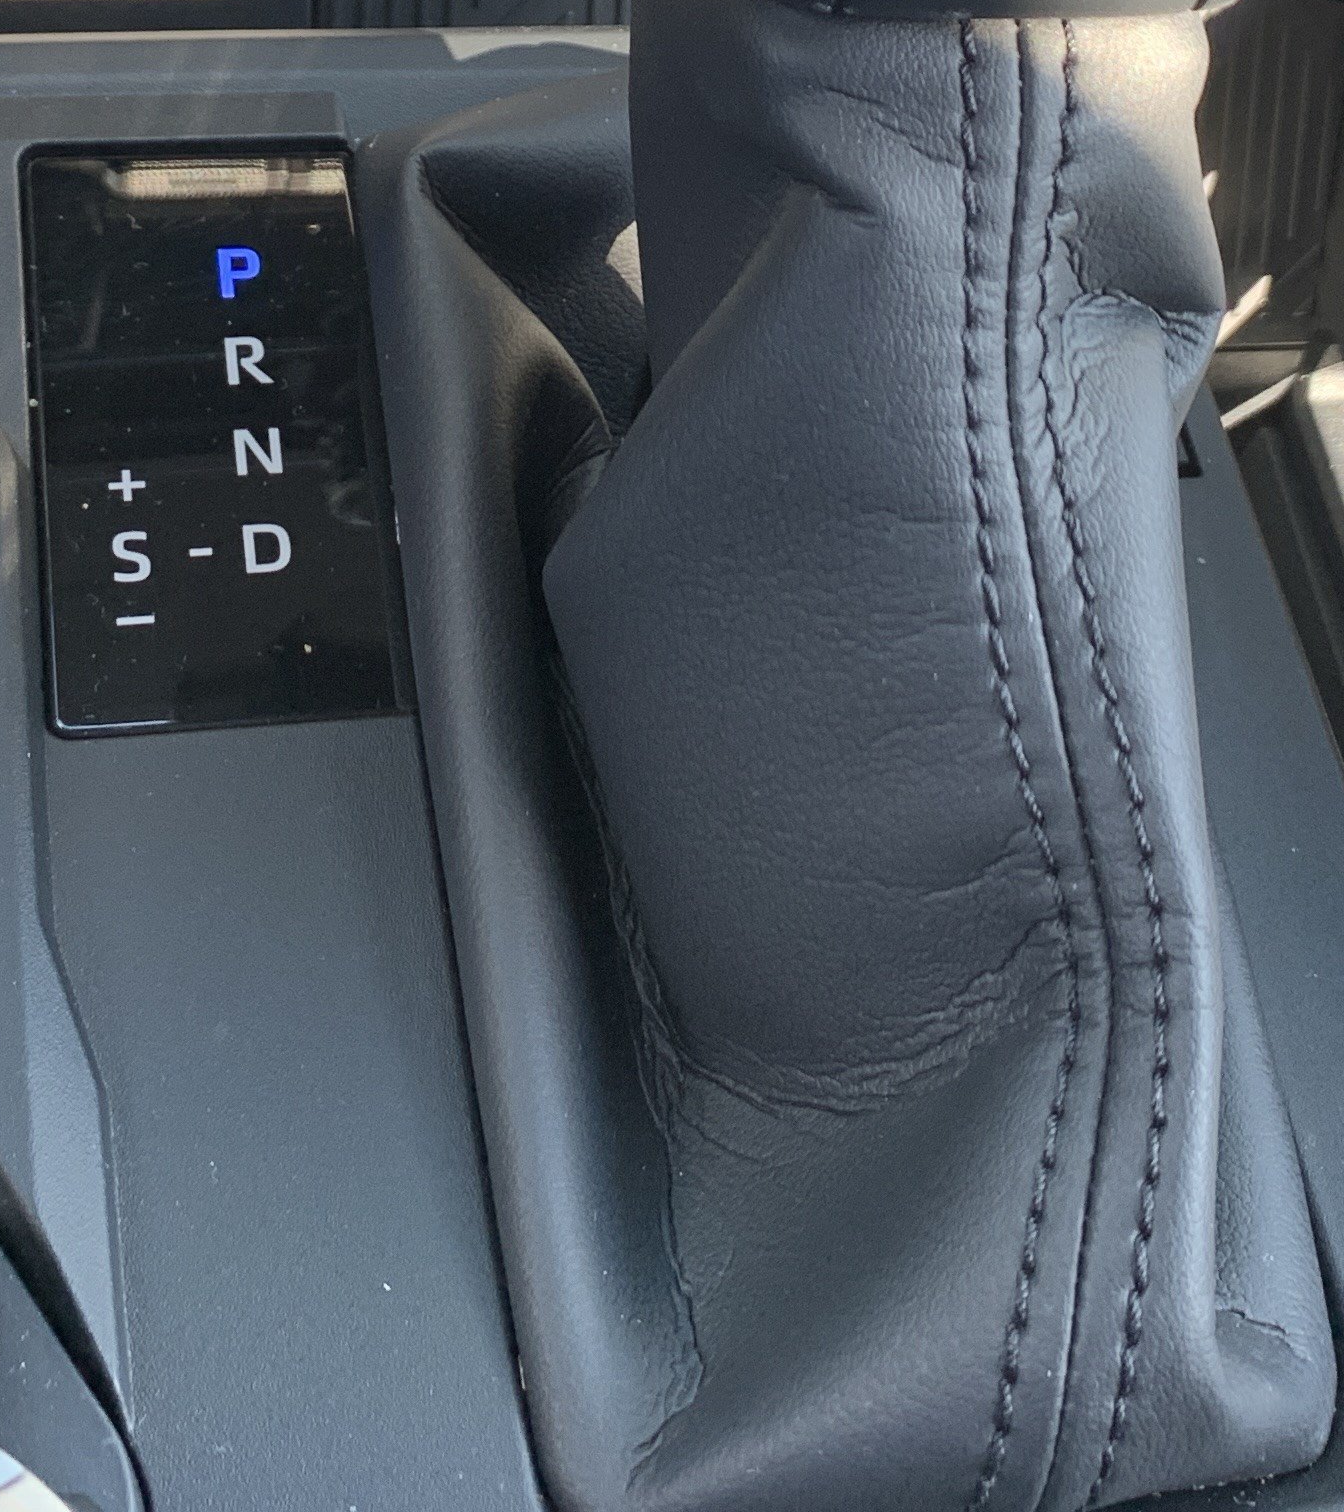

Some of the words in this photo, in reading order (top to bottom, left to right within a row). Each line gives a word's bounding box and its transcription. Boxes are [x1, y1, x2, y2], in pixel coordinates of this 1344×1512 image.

[215, 246, 261, 300] P
[222, 335, 274, 386] R
[232, 426, 284, 477] N
